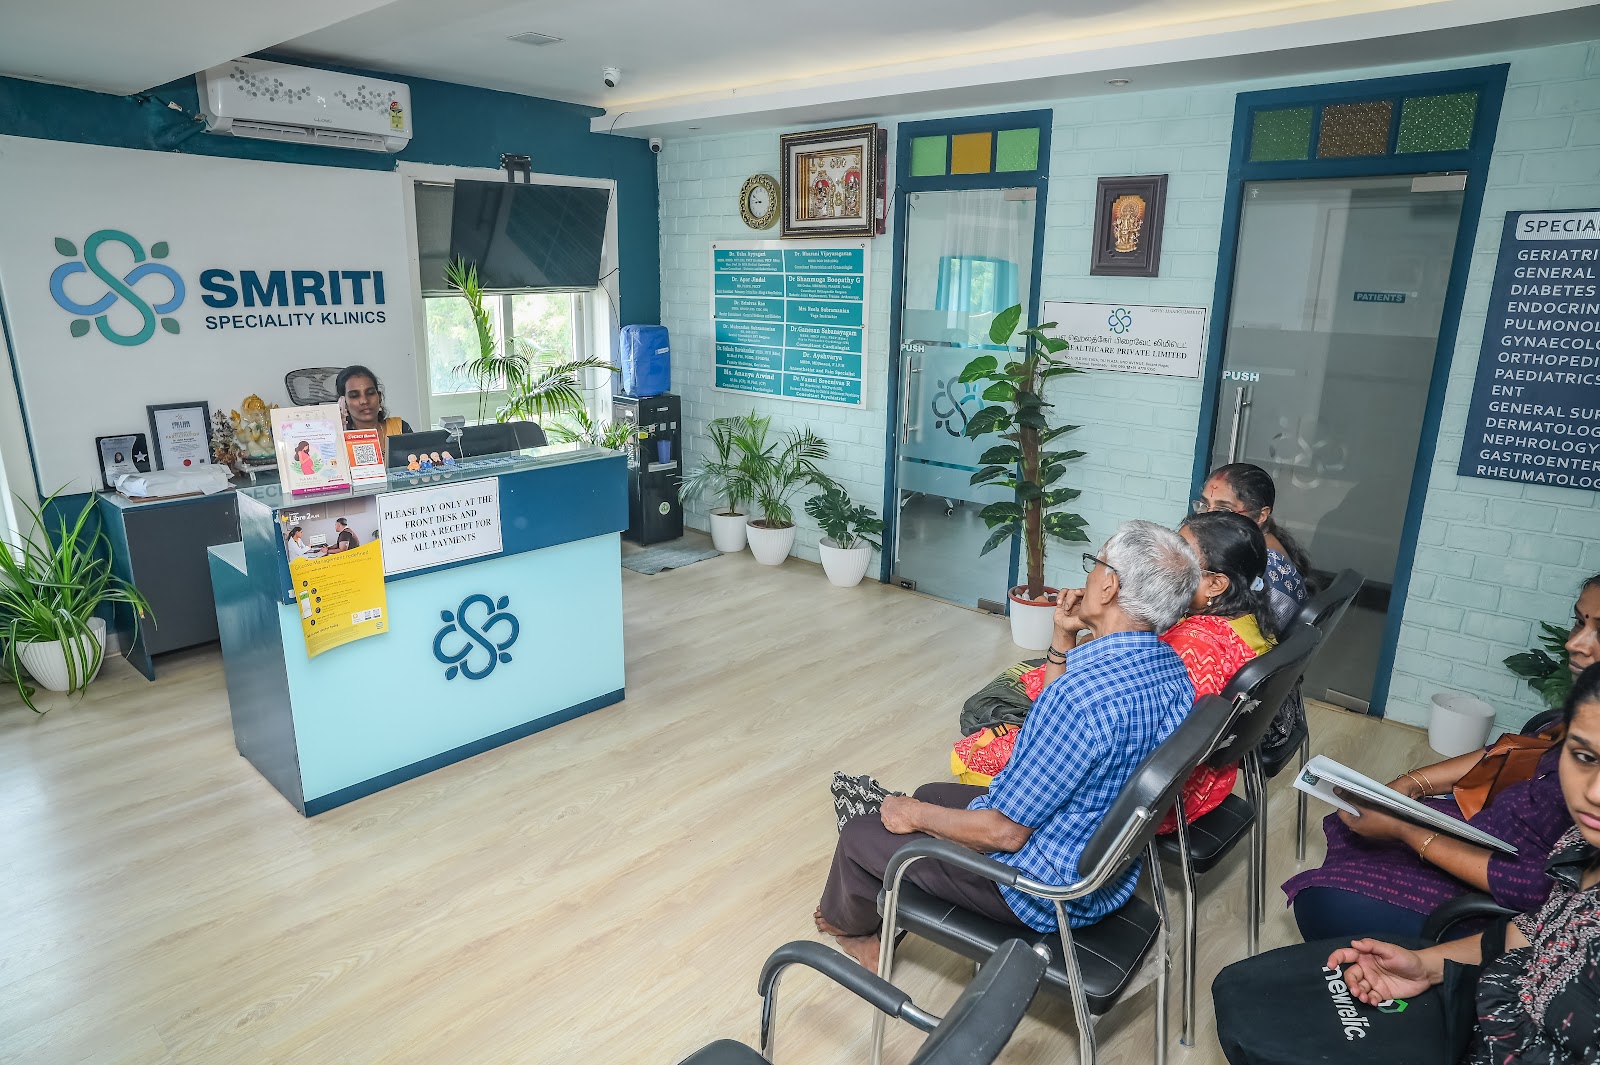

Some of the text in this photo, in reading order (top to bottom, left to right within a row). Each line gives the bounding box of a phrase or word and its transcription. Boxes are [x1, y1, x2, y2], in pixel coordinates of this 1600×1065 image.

[1523, 218, 1600, 233] SPECIA
[1517, 249, 1598, 262] GERIATRI
[1514, 266, 1596, 279] GENERAL
[199, 269, 386, 309] SMRITI
[1510, 284, 1597, 297] DIABETES
[1357, 293, 1402, 302] PATIENTS
[1507, 301, 1600, 315] ENDOCRIN
[205, 312, 386, 330] SPECIALITY KLINICS
[900, 343, 925, 353] PUSH
[1117, 348, 1151, 357] PRIVATE
[1152, 350, 1187, 359] LIMITED
[1497, 352, 1599, 368] ORTHOPEDI
[1222, 370, 1260, 382] PUSH
[1491, 385, 1525, 397] ENT
[1488, 401, 1566, 418] GENERAL
[1485, 417, 1600, 438] DERMATOLOG
[1482, 433, 1599, 454] NEPHROLOGY
[384, 494, 494, 520] PLEASE PAY ONLY AT THE
[404, 509, 477, 529] FRONT DESK AND
[390, 518, 492, 545] ASK FOR A RECEIPT FOR
[412, 532, 477, 553] ALL PAYMENTS
